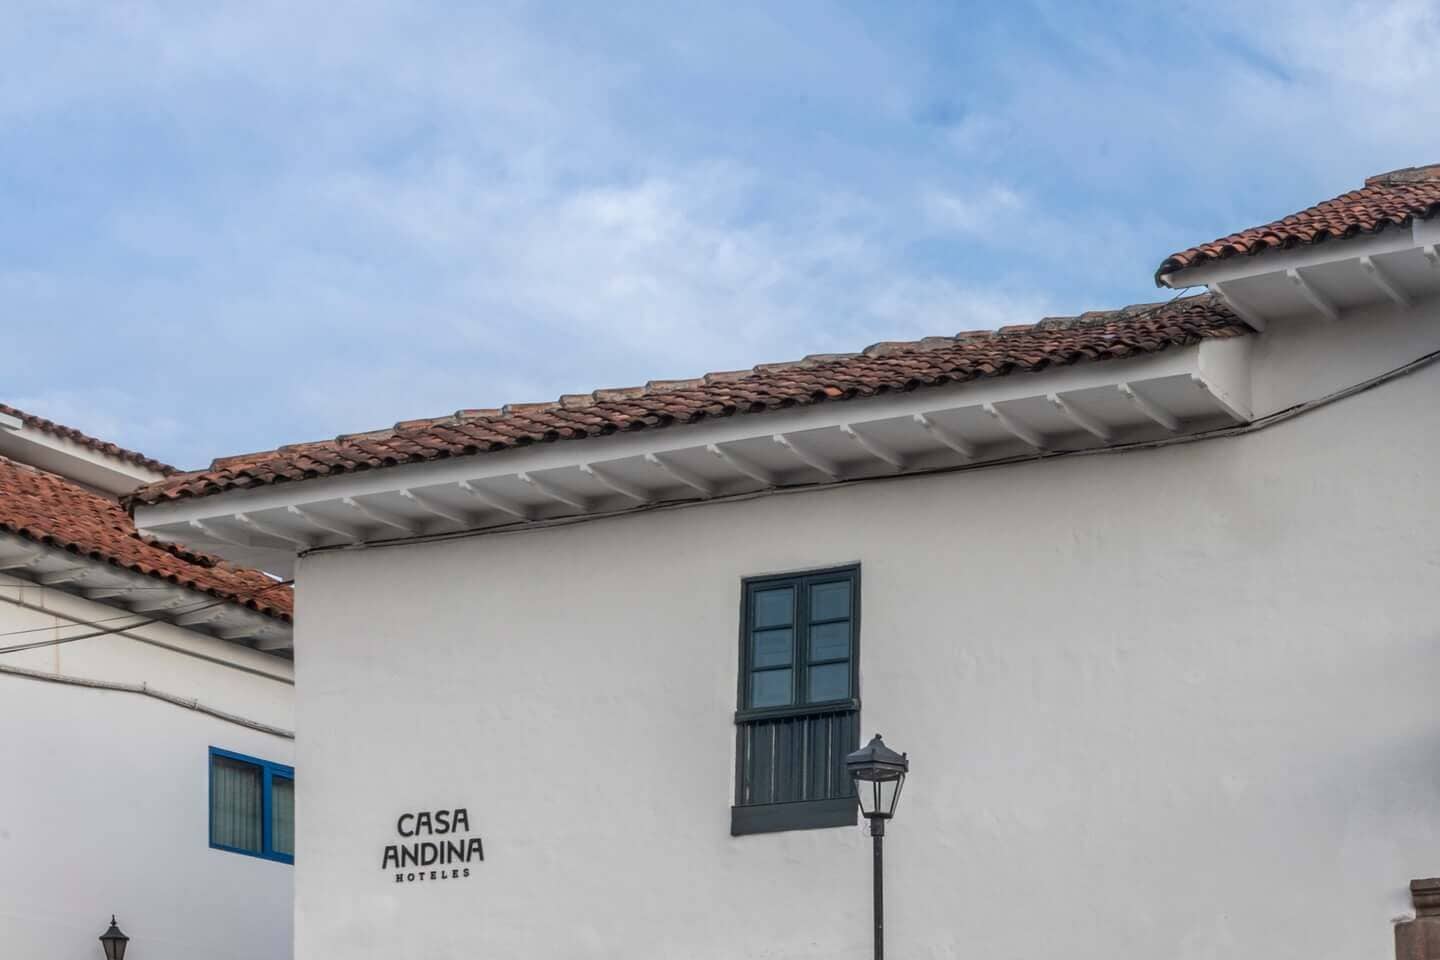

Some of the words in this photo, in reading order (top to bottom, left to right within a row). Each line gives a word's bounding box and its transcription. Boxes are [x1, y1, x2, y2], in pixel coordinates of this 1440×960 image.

[397, 808, 469, 838] CASA
[382, 838, 484, 870] ANDINA
[395, 868, 470, 883] HOTELES
